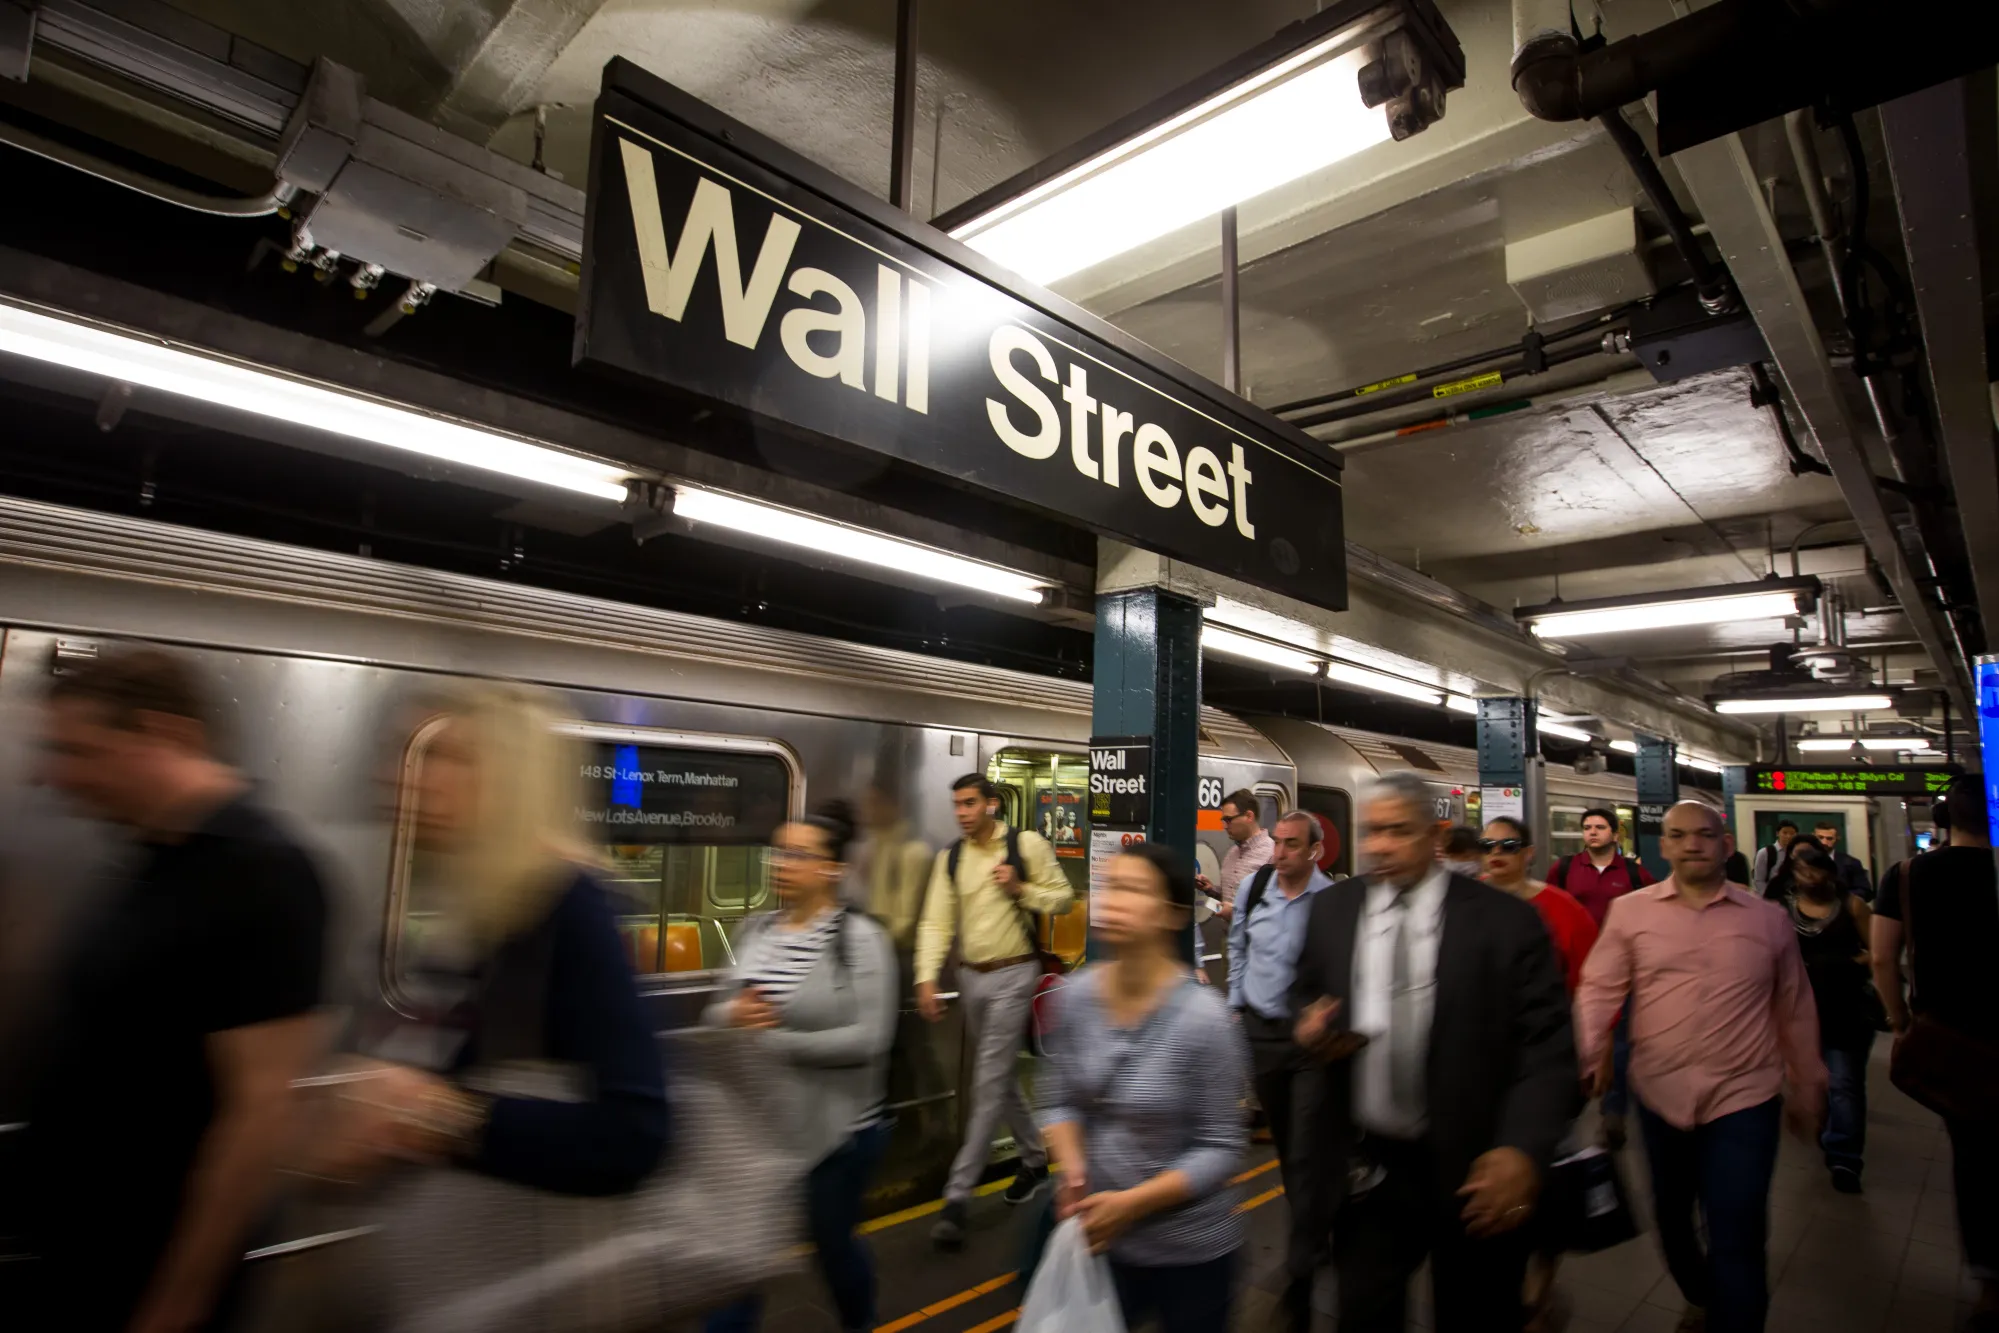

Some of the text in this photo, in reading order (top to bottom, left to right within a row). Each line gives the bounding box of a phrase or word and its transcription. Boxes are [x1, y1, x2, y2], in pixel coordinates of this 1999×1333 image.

[618, 136, 1256, 541] Wall Street
[1090, 750, 1126, 770] Wall
[580, 765, 602, 778] 148
[684, 771, 739, 787] Manhattan
[1090, 774, 1146, 795] Street
[1198, 778, 1222, 808] 66
[683, 810, 736, 828] Brooklyn
[1640, 804, 1663, 814] Wall
[1640, 813, 1663, 823] Stre
